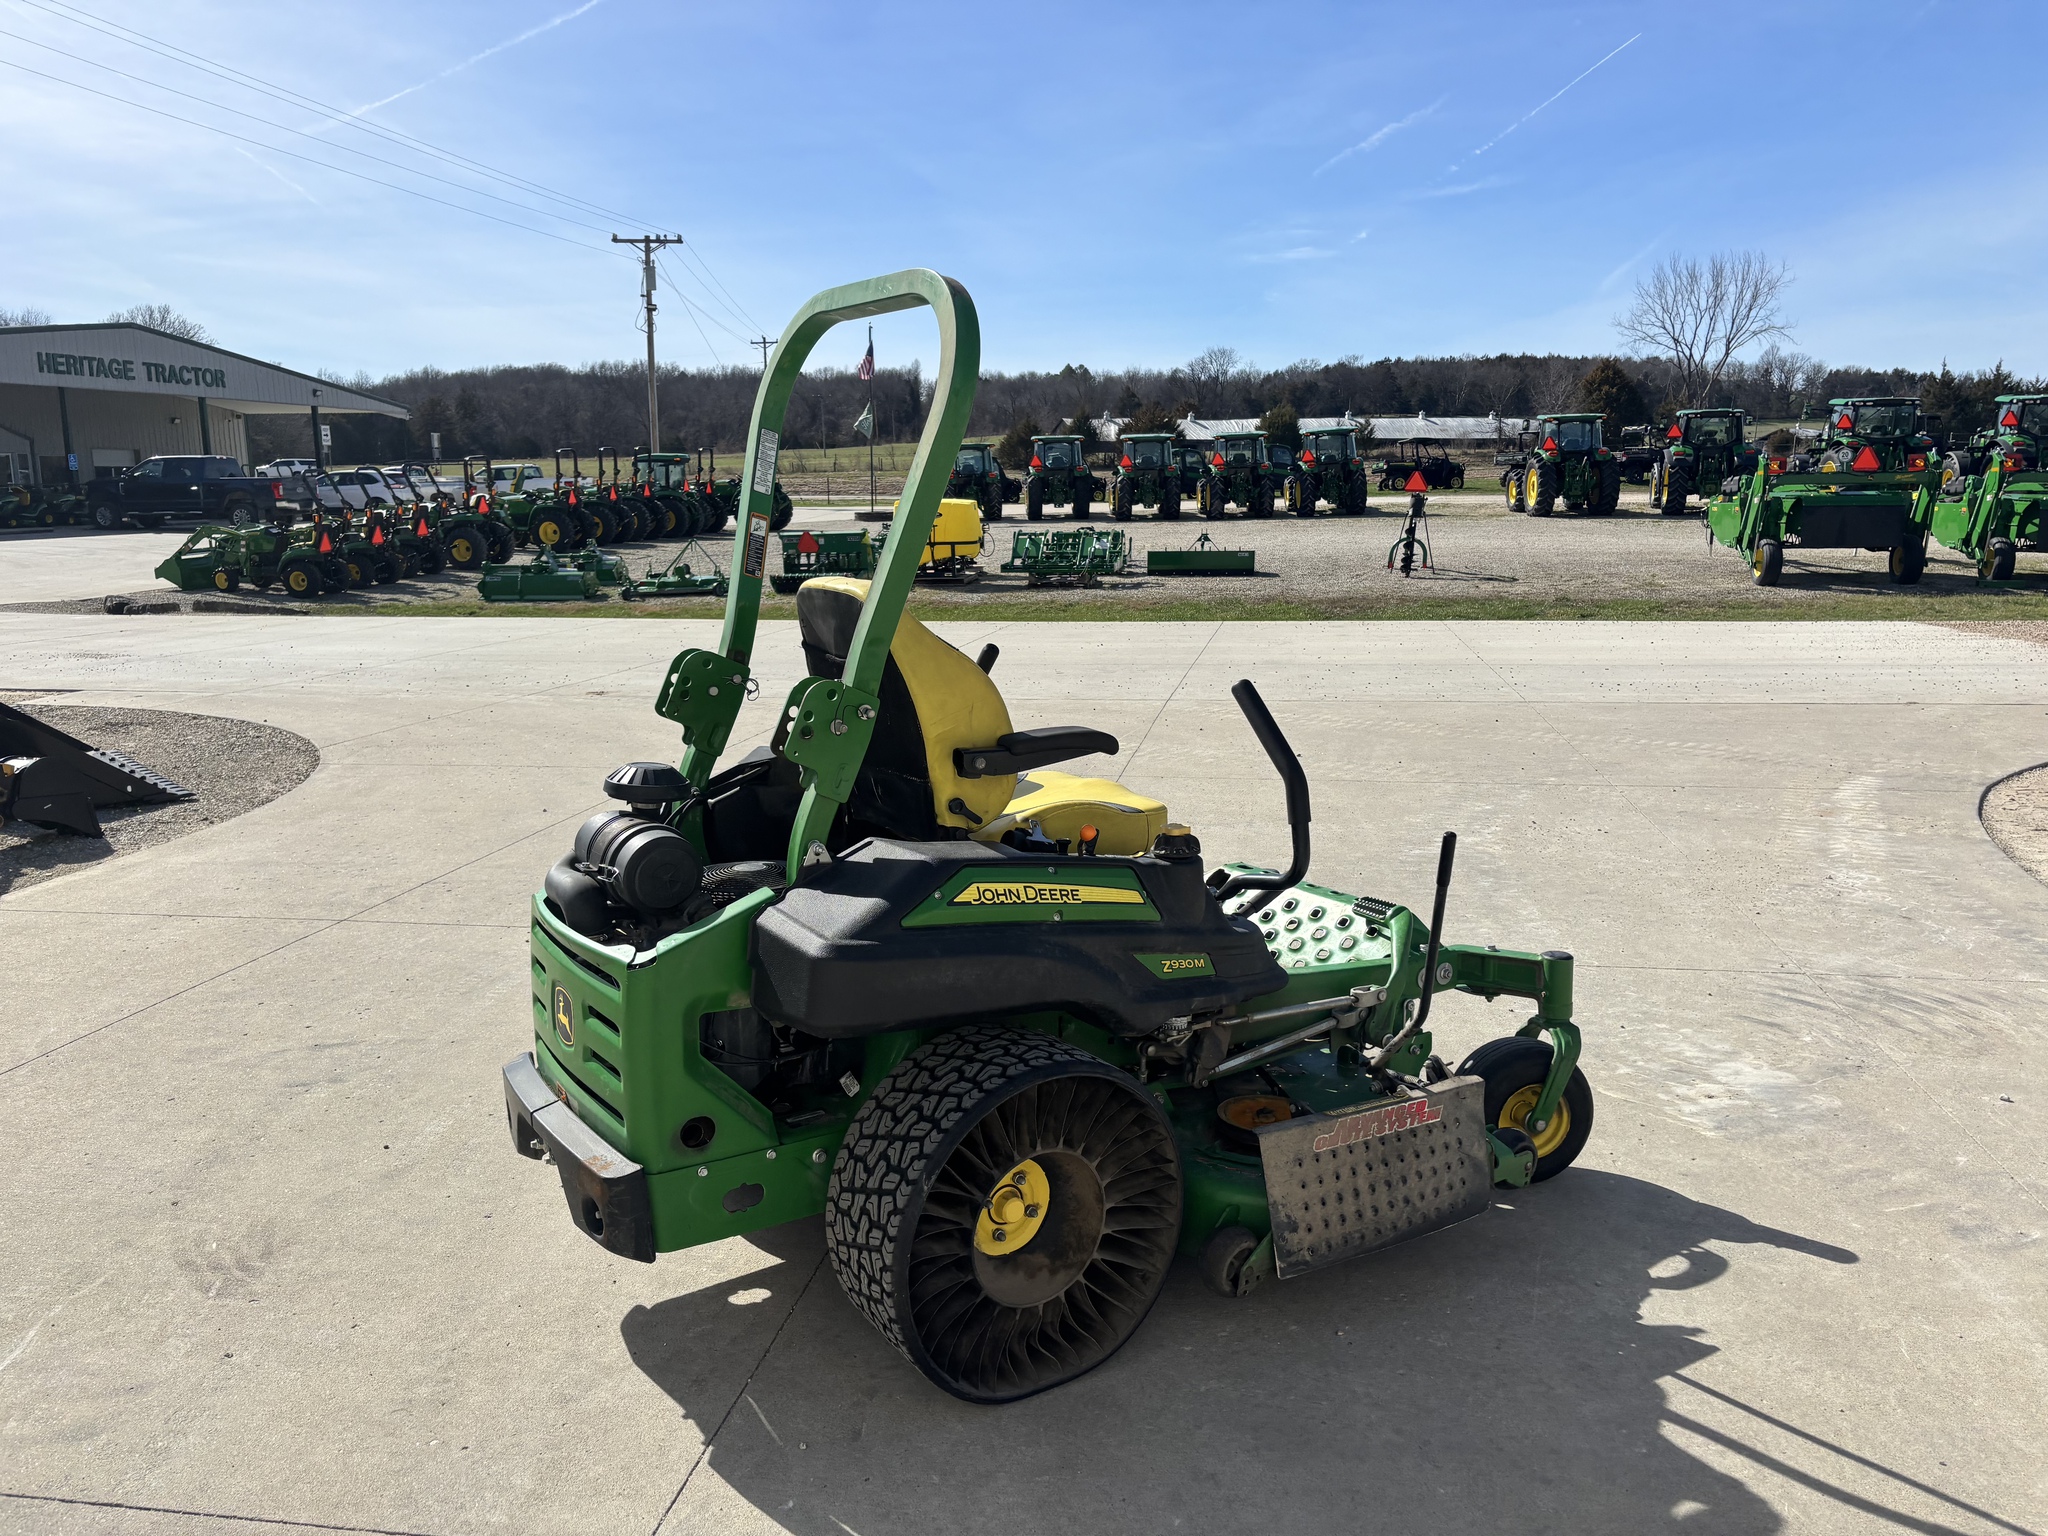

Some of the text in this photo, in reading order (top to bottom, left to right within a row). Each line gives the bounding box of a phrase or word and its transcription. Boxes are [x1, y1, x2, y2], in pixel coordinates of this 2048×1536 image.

[36, 351, 226, 388] HERITAGE TRACTOR
[972, 885, 1082, 902] JOHN DEERE
[1160, 958, 1205, 973] Z930M
